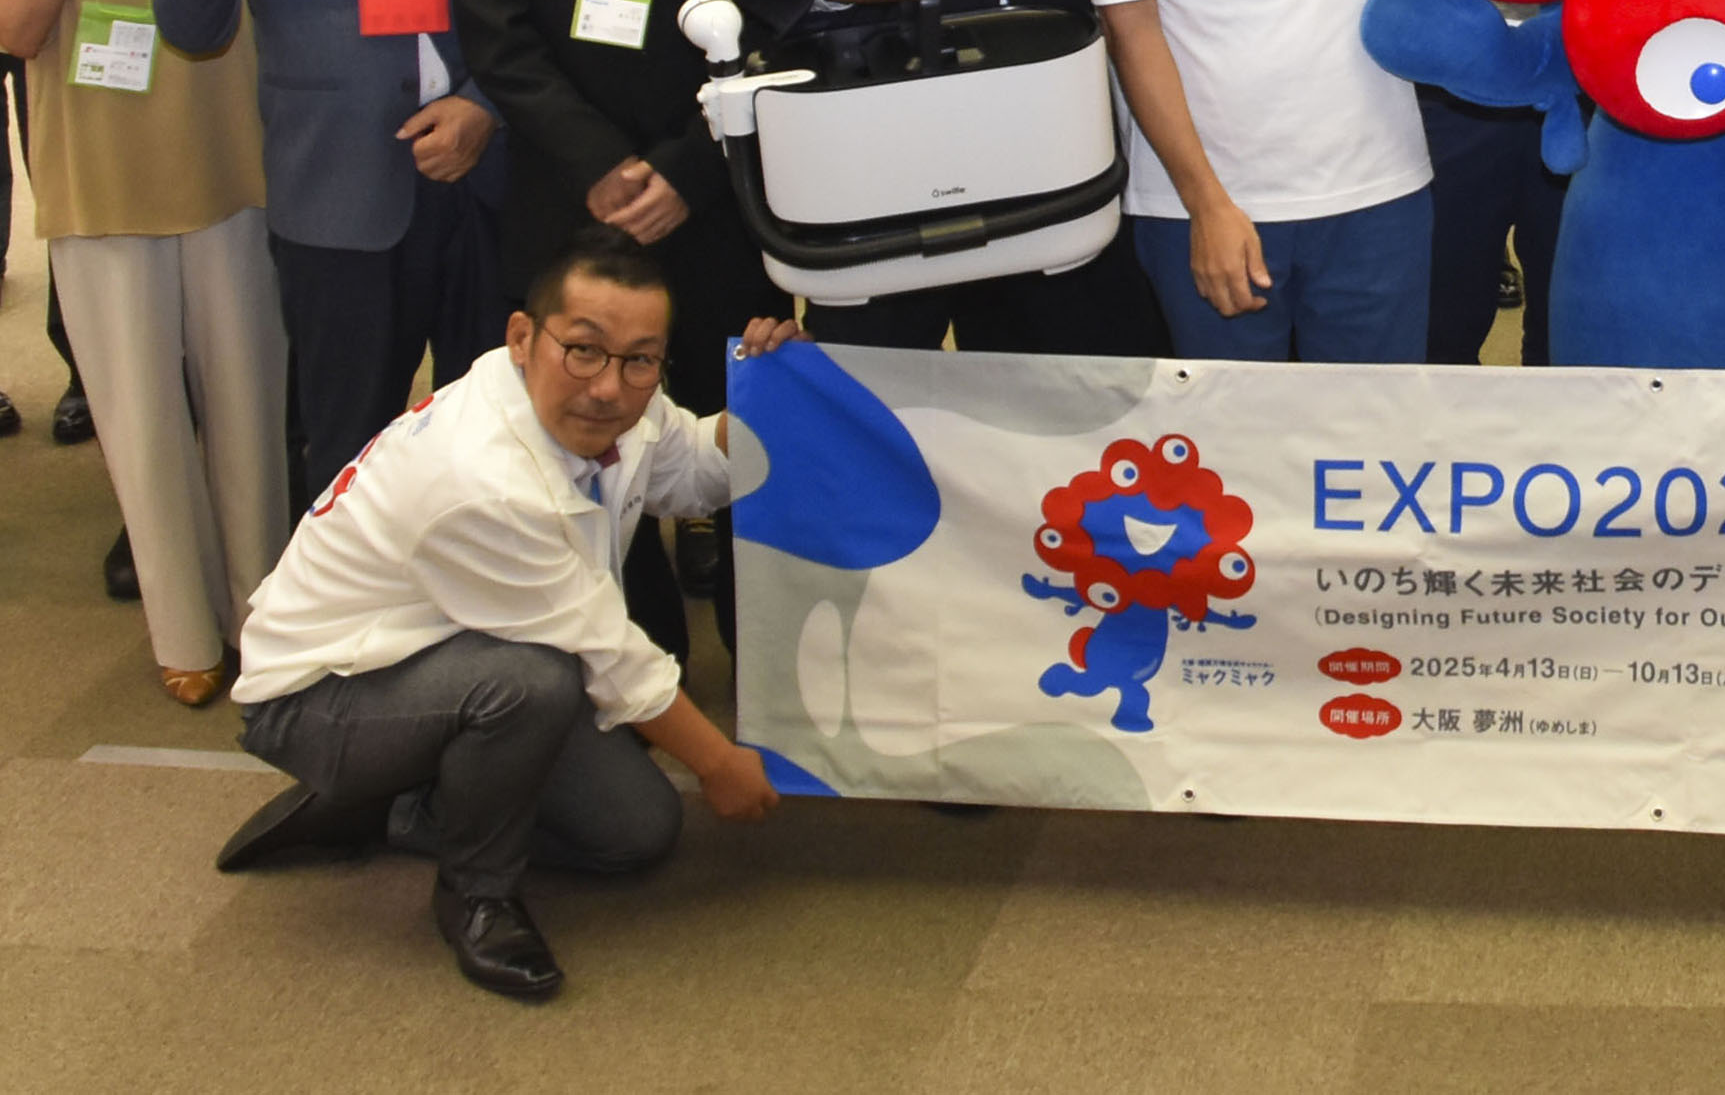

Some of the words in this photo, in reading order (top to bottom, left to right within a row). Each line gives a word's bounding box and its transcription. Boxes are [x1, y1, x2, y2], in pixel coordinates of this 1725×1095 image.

[1314, 606, 1450, 629] (Designing
[1461, 607, 1542, 624] Future
[1552, 606, 1646, 629] Society
[1655, 607, 1691, 625] for
[1182, 667, 1275, 686] ミャクミャク
[1328, 659, 1390, 674] 開催期間
[1329, 708, 1390, 726] 開催場所
[1412, 707, 1462, 733] 大阪
[1472, 708, 1524, 734] 夢洲
[1529, 719, 1597, 736] (ゆめしま)
